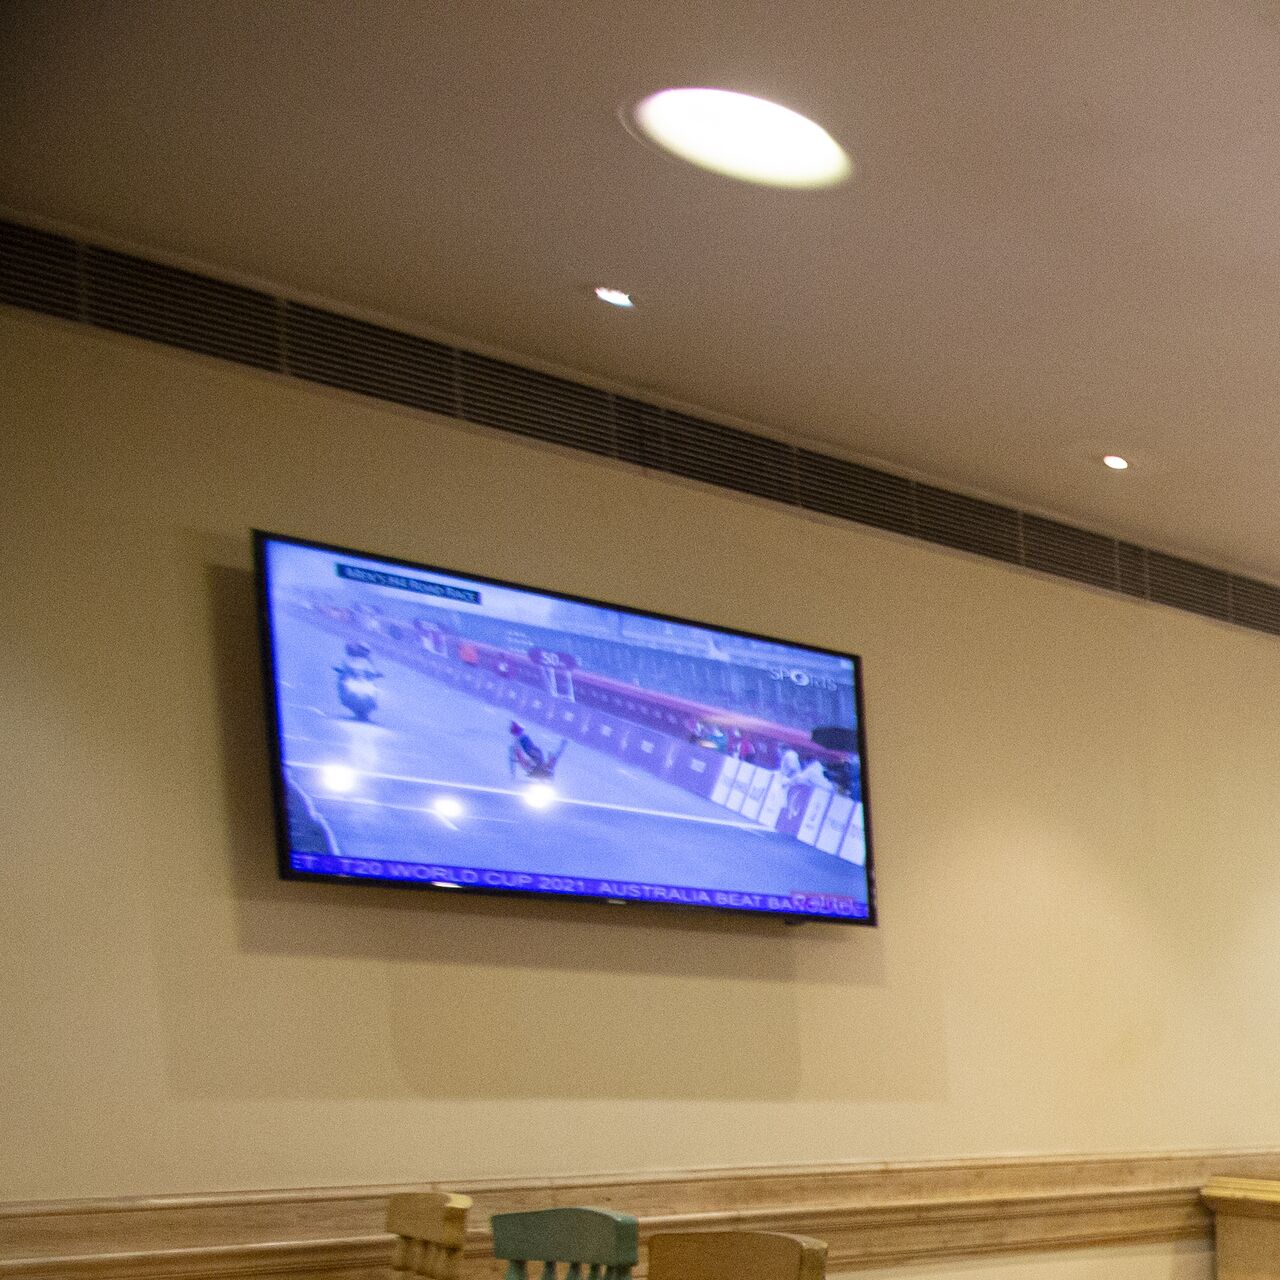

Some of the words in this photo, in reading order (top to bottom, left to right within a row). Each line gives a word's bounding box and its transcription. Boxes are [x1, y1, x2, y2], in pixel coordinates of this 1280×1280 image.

[340, 858, 384, 875] T20
[389, 863, 479, 884] WORLD
[483, 872, 534, 888] CUP
[599, 883, 711, 903] AUSTRALIA
[717, 891, 762, 908] BEAT
